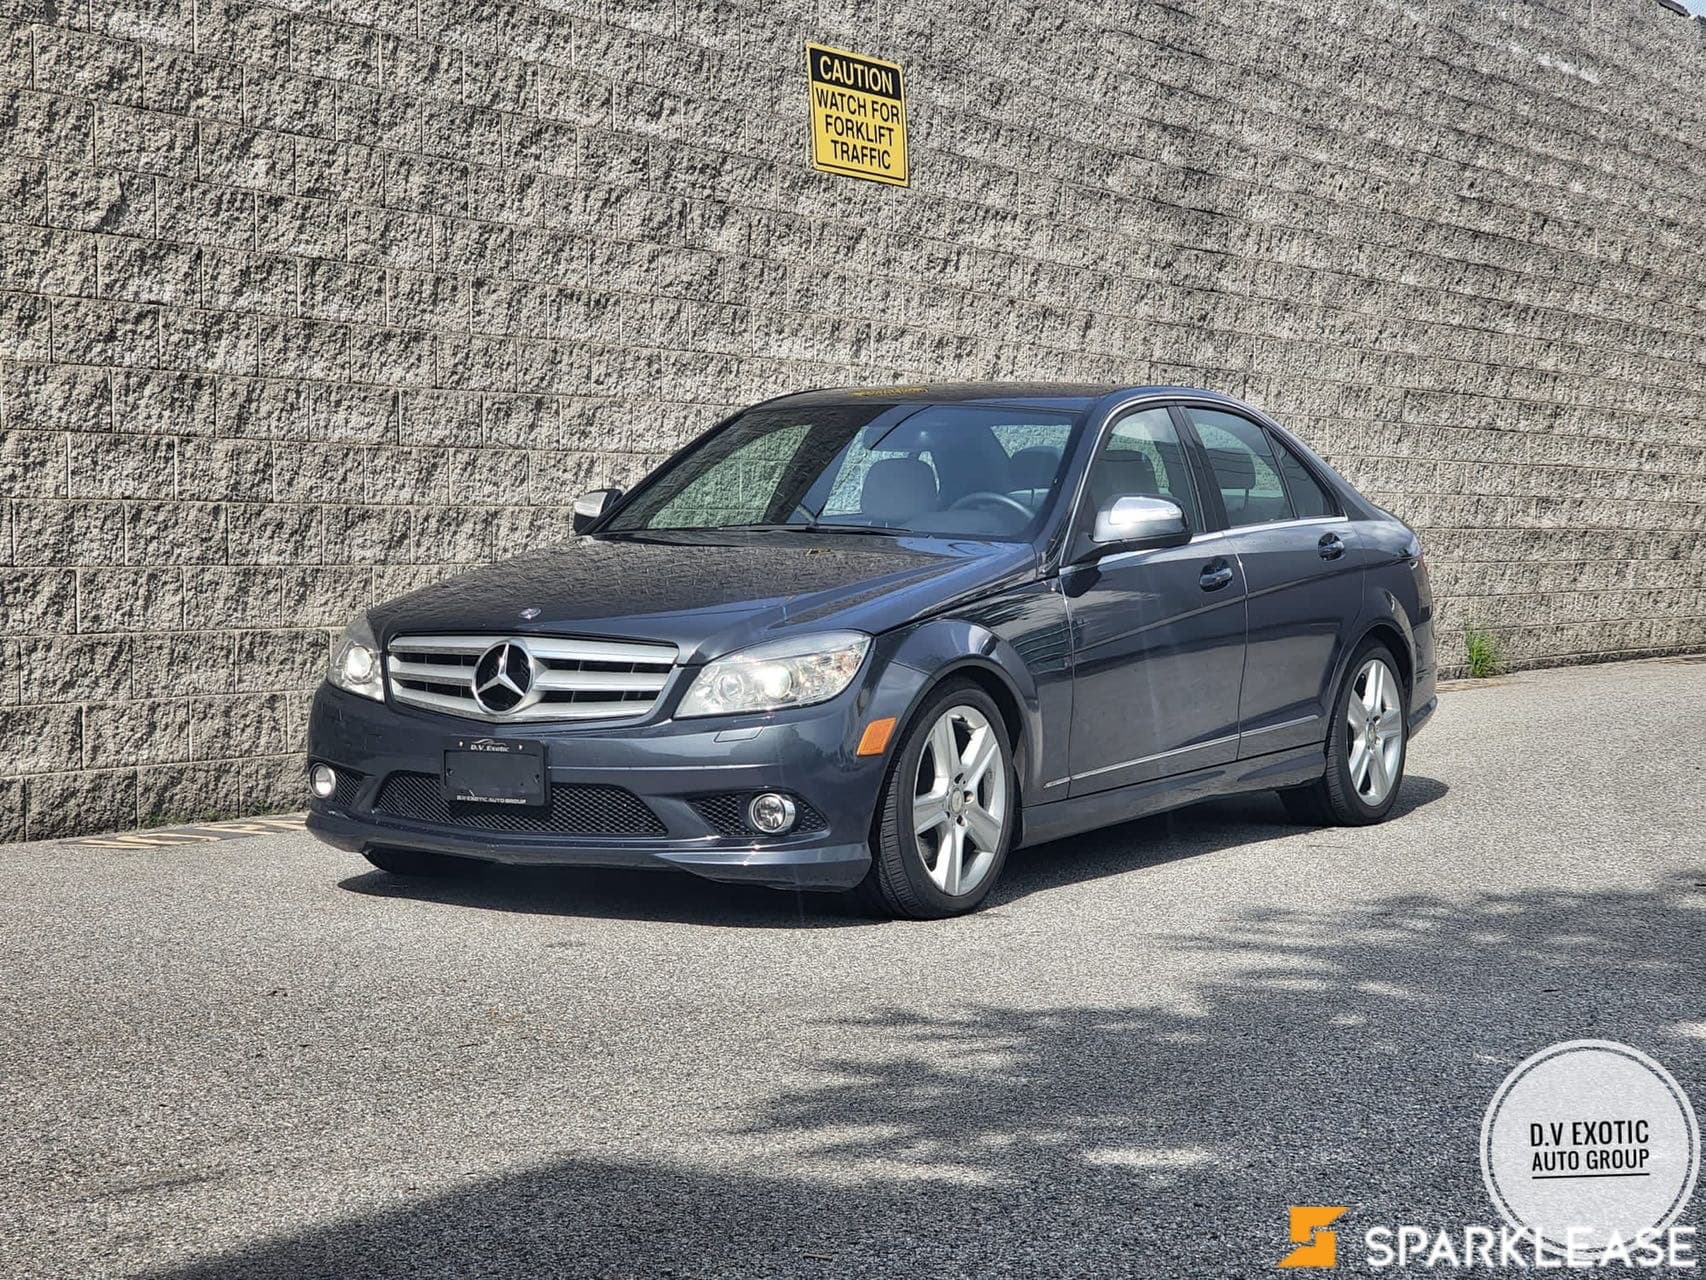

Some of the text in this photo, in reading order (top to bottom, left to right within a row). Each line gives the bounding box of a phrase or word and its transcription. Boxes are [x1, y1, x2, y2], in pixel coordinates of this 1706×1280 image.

[819, 55, 894, 95] CAUTION
[816, 87, 900, 125] WATCH FOR
[825, 114, 894, 147] FORKLIFT
[830, 139, 891, 170] TRAFFIC
